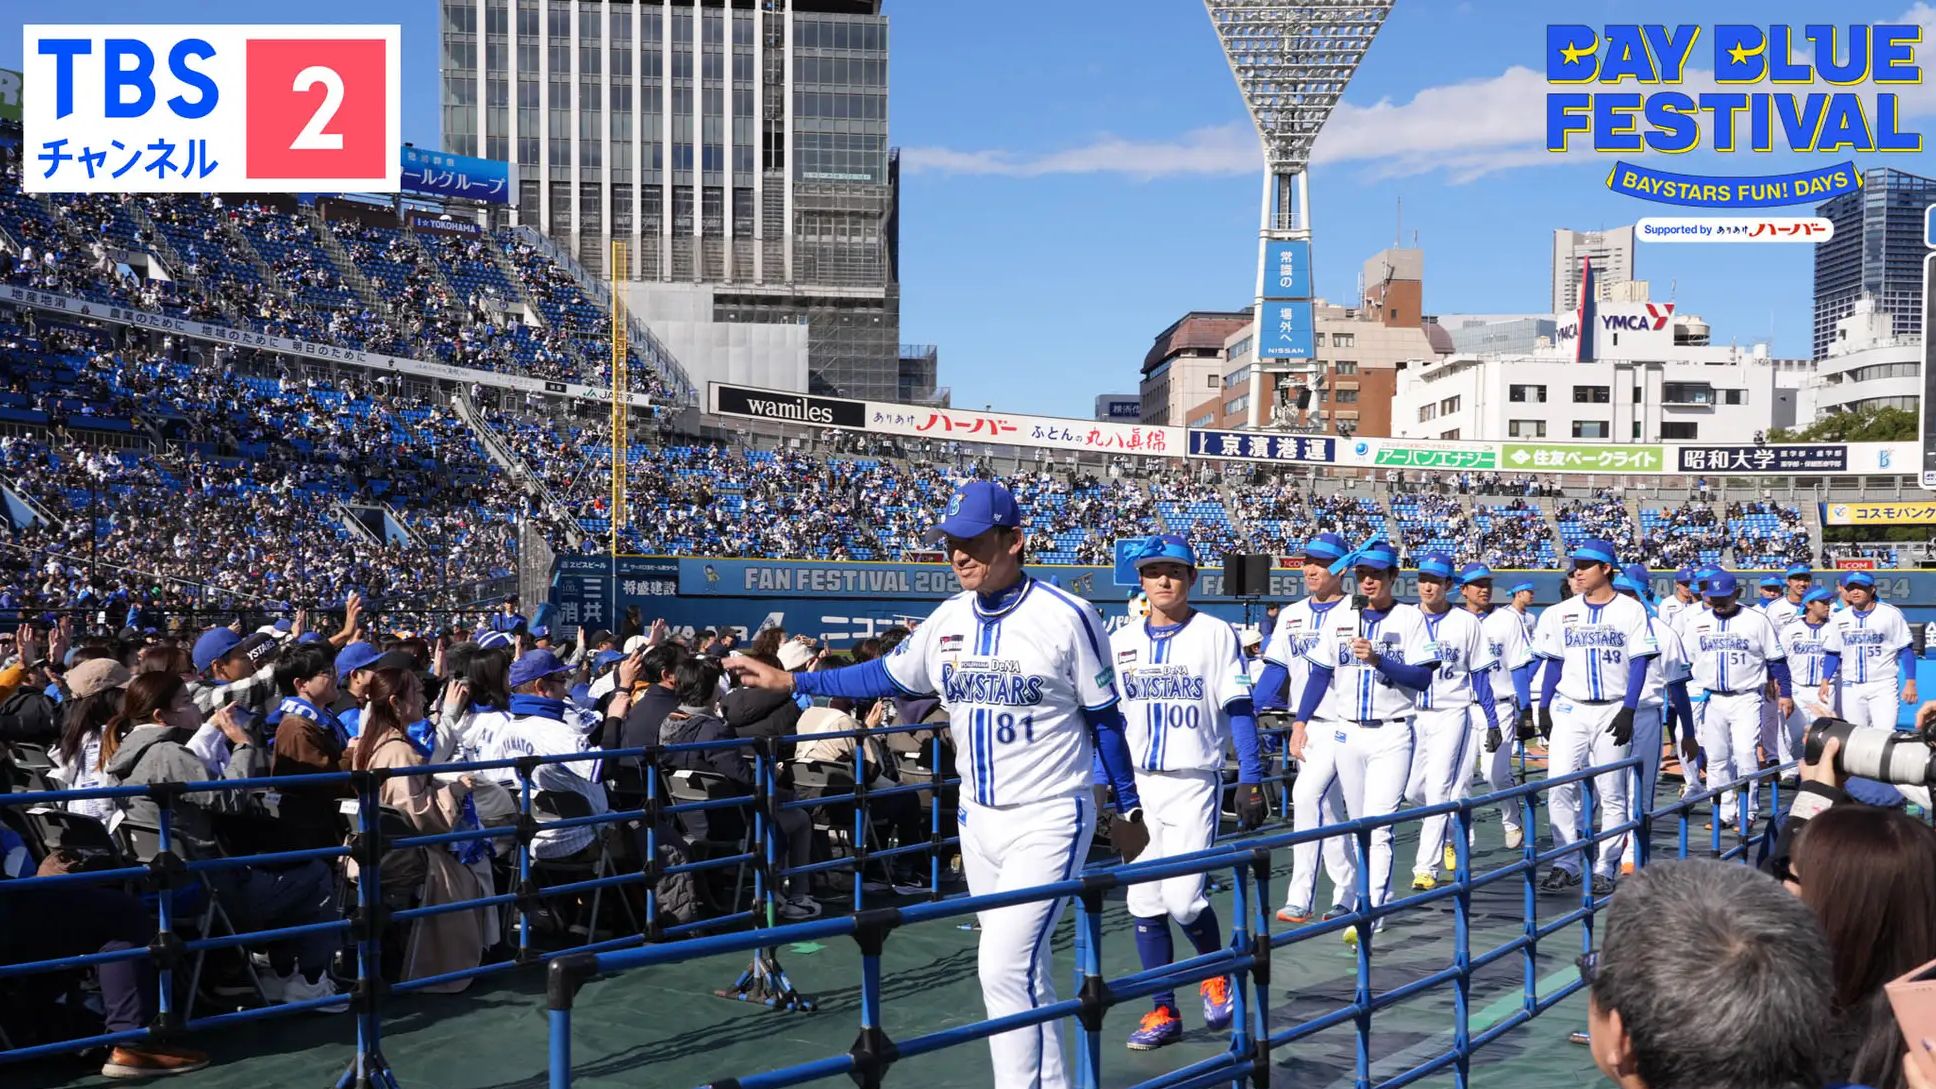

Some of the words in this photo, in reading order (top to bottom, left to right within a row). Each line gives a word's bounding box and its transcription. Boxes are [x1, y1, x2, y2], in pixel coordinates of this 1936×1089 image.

[400, 166, 507, 194] ールグループ
[430, 219, 477, 234] YOKOHAMA
[1556, 322, 1579, 342] YMCA
[1602, 315, 1649, 331] YMCA
[746, 397, 834, 424] wamiles
[872, 411, 916, 427] ありあけ
[916, 413, 1018, 435] ハーバー
[1379, 449, 1495, 467] アーバンエナジー
[1533, 448, 1657, 467] 住友ベークライト
[1684, 449, 1776, 470] 昭和大学
[1855, 507, 1936, 519] コスモバンク
[744, 566, 792, 591] FAN
[797, 567, 910, 593] FESTIVAL
[914, 570, 962, 594] 202
[1564, 626, 1625, 649] BAYSTARS
[1699, 635, 1750, 652] BAYSTARS
[246, 638, 277, 661] YSTARS
[1731, 652, 1747, 665] 51
[1866, 645, 1883, 658] 55
[991, 658, 1021, 673] DeNA
[1438, 665, 1455, 680] 16
[941, 661, 1044, 706] BAYSTARS
[1168, 704, 1200, 729] 00
[996, 712, 1034, 745] 81
